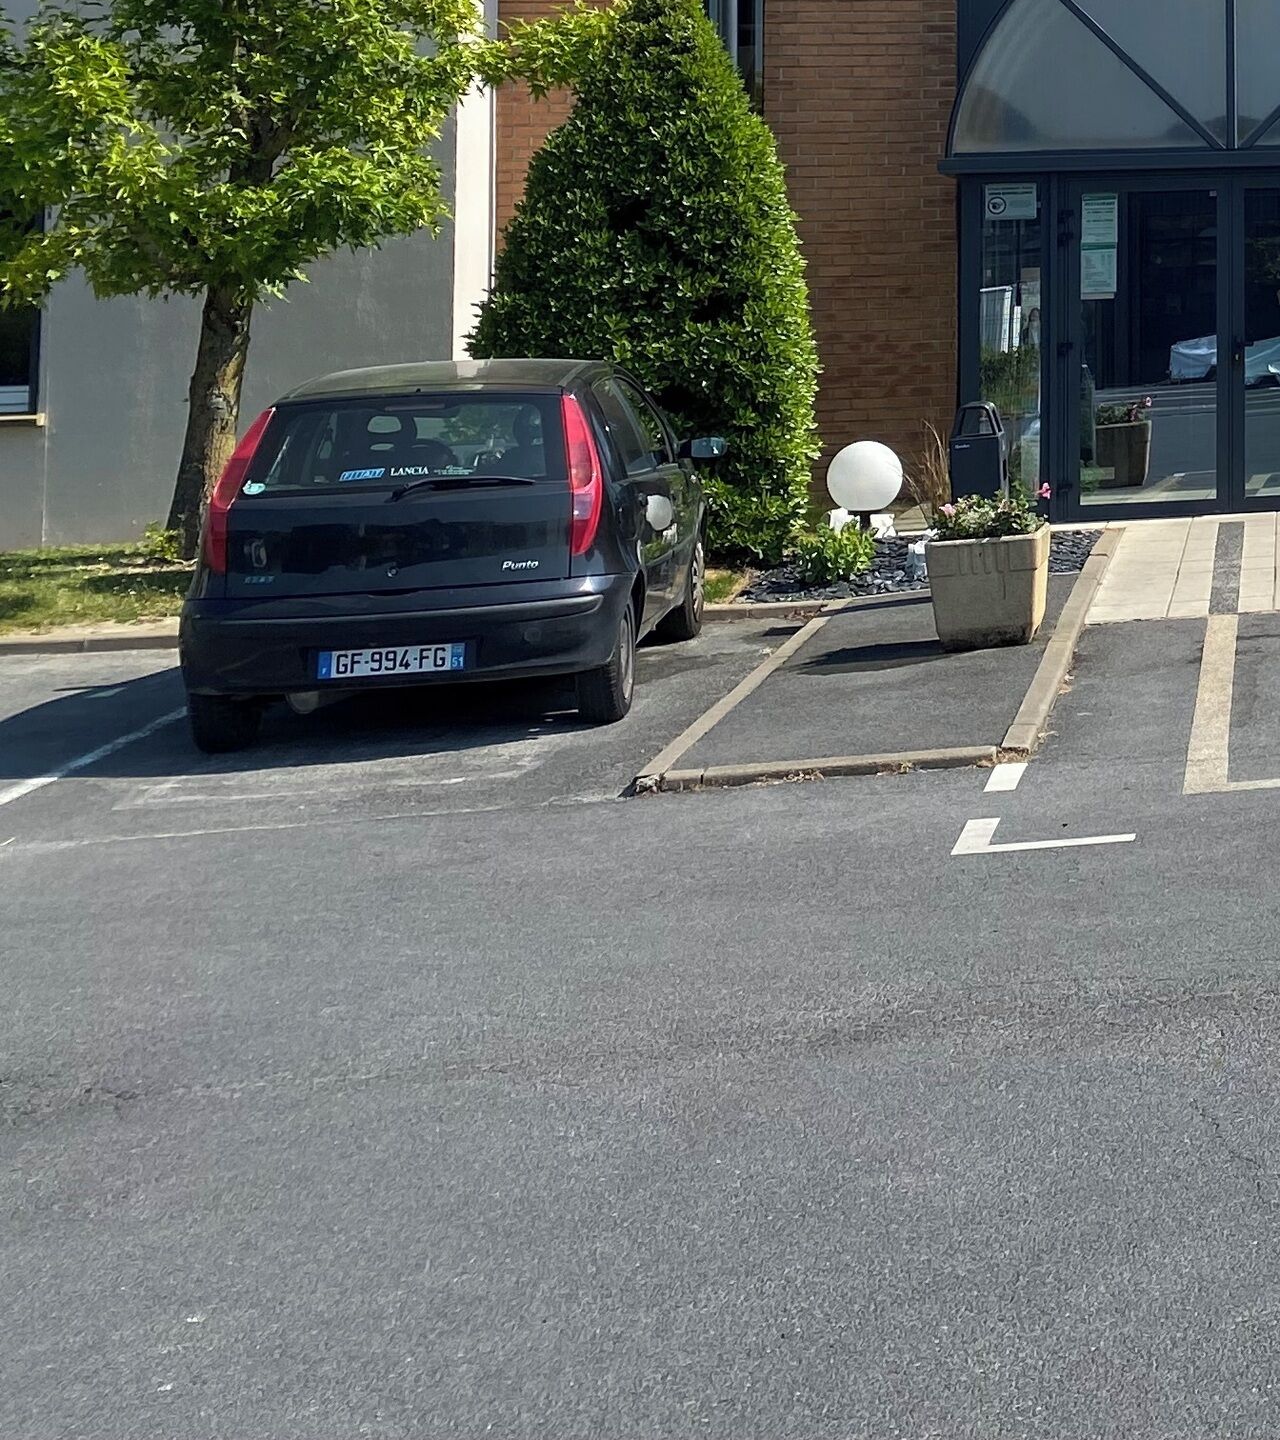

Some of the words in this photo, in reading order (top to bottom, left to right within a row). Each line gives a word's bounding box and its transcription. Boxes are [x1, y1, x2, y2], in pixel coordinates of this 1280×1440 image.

[390, 466, 429, 477] LANCIA
[502, 560, 539, 571] Punto
[336, 647, 447, 675] GF-994-FG
[452, 656, 464, 668] 51
